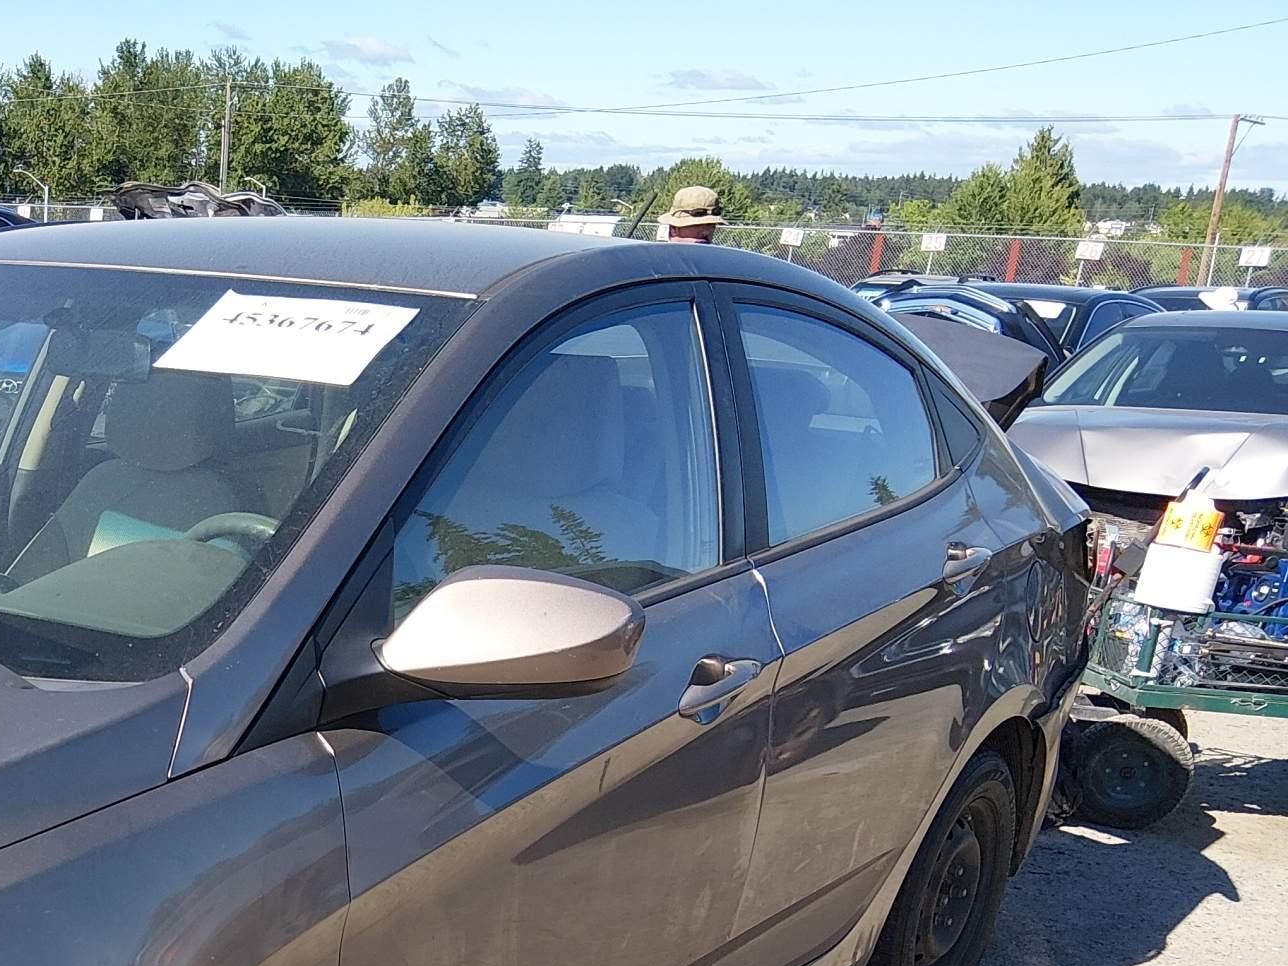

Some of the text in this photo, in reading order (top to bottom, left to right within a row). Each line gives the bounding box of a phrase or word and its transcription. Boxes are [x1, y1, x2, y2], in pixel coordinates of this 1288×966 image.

[924, 235, 943, 250] 25
[1078, 243, 1100, 259] 26
[1244, 249, 1265, 265] 27
[222, 312, 376, 336] 45367674
